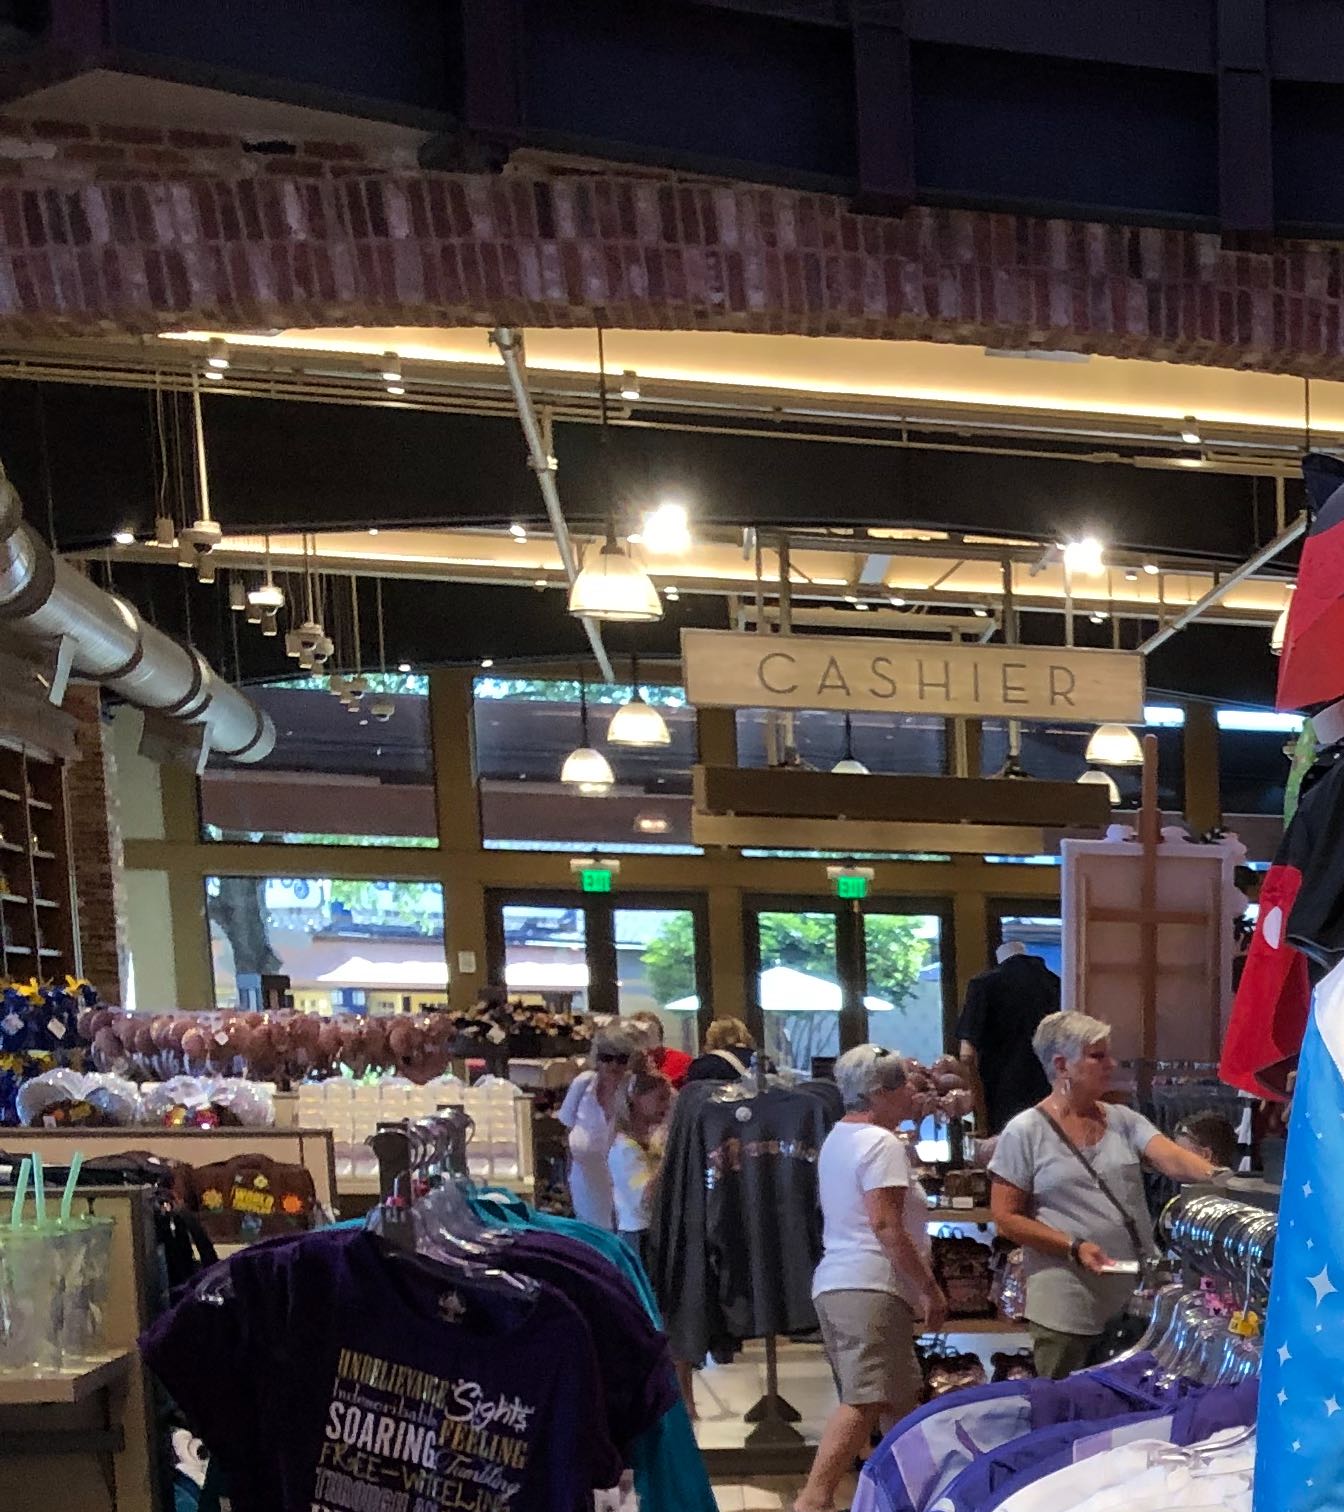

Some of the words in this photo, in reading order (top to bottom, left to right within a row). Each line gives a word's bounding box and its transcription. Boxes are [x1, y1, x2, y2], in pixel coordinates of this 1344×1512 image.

[758, 652, 1077, 707] CASHIER
[445, 1380, 536, 1433] Sights
[325, 1400, 438, 1471] SOARING
[438, 1418, 529, 1470] FEELING
